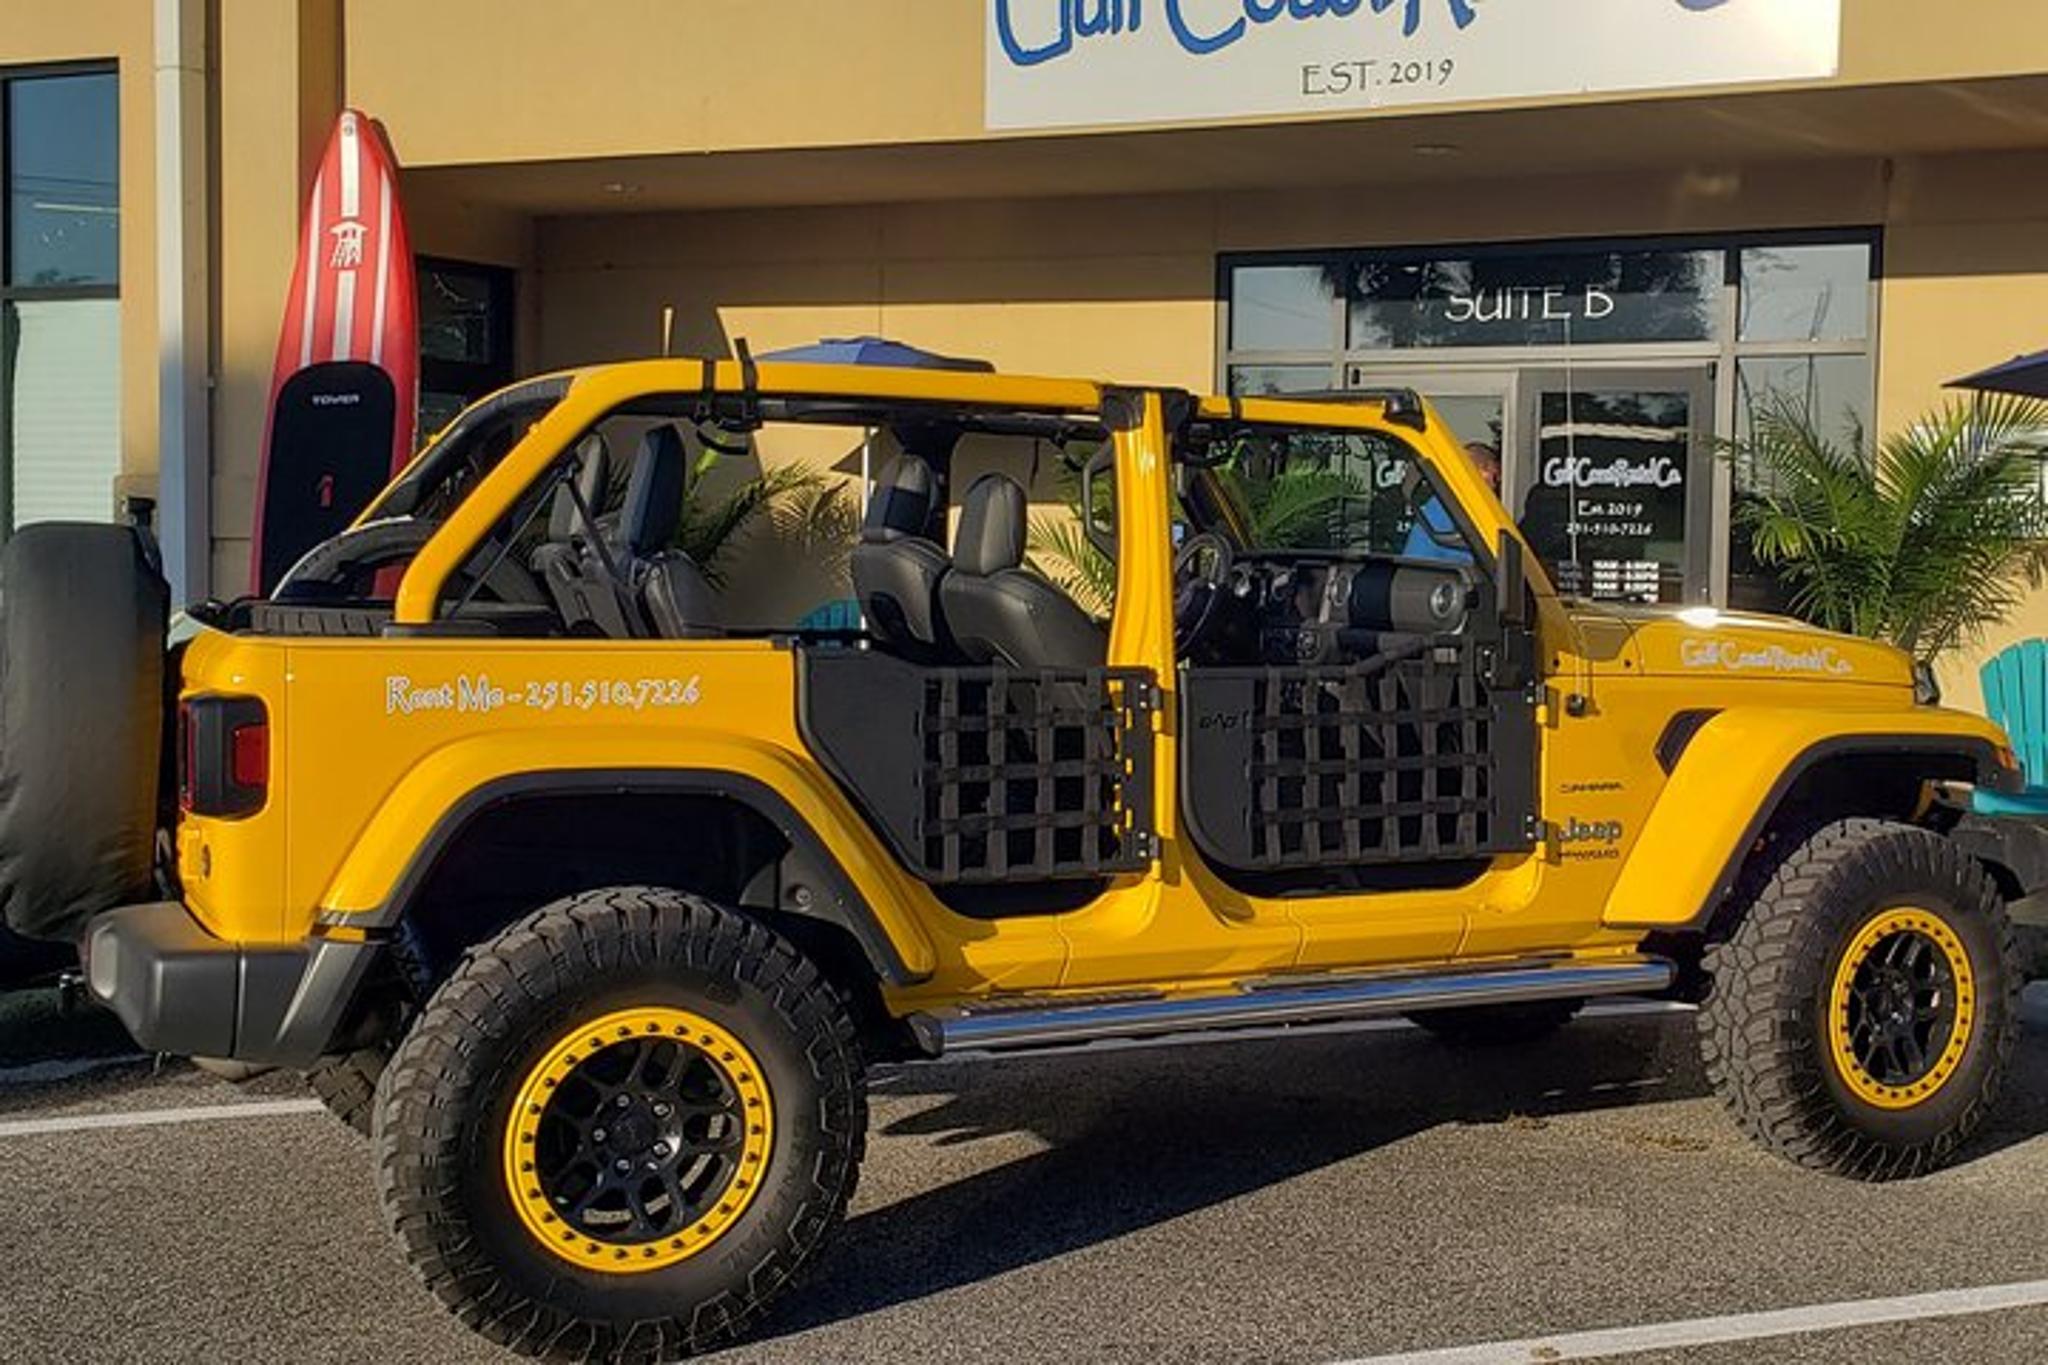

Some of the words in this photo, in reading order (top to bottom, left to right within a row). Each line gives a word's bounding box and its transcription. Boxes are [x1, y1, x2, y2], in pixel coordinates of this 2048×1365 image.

[1301, 60, 1382, 95] EST.
[1390, 58, 1455, 85] 2019
[1444, 285, 1572, 322] SUITE
[1558, 816, 1622, 845] Jeep
